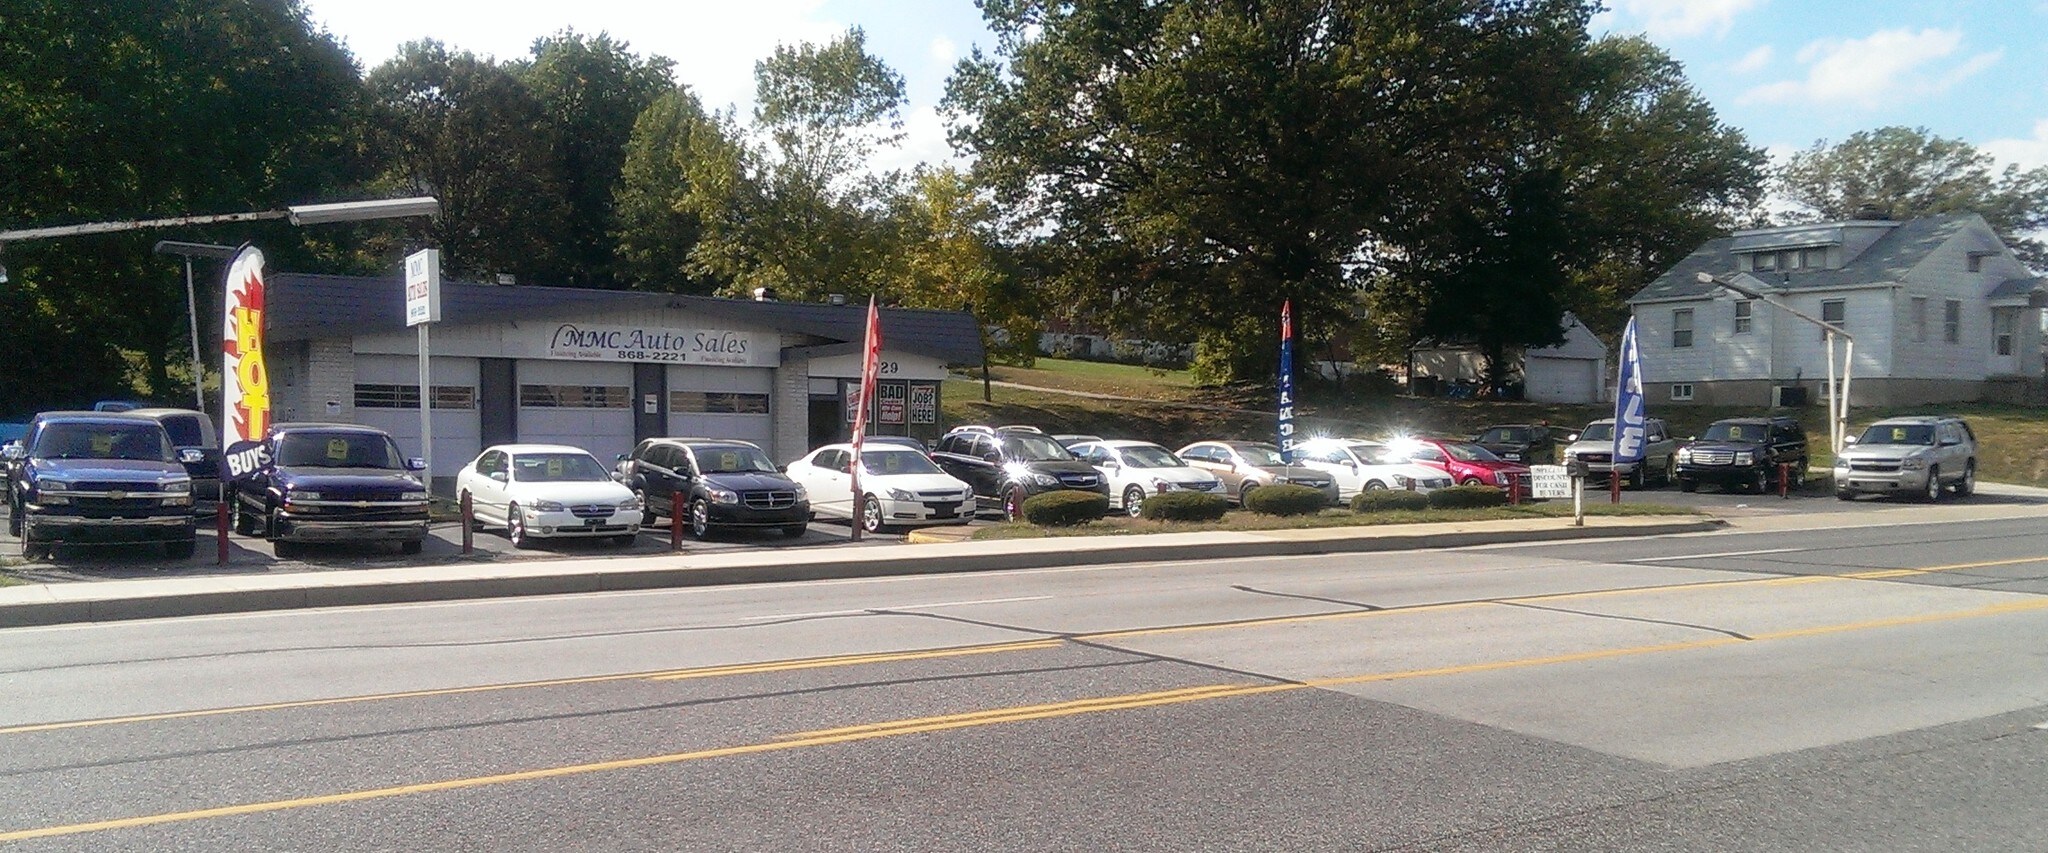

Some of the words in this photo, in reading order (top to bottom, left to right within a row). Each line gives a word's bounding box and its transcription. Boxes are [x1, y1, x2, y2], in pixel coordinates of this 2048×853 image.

[561, 328, 621, 349] MMC
[624, 329, 685, 350] Auto
[692, 331, 748, 354] Sales
[617, 350, 687, 362] 868-2221
[880, 385, 904, 399] BAD
[912, 392, 934, 404] JOB?
[912, 408, 934, 422] HERE!
[227, 444, 271, 476] BUYS
